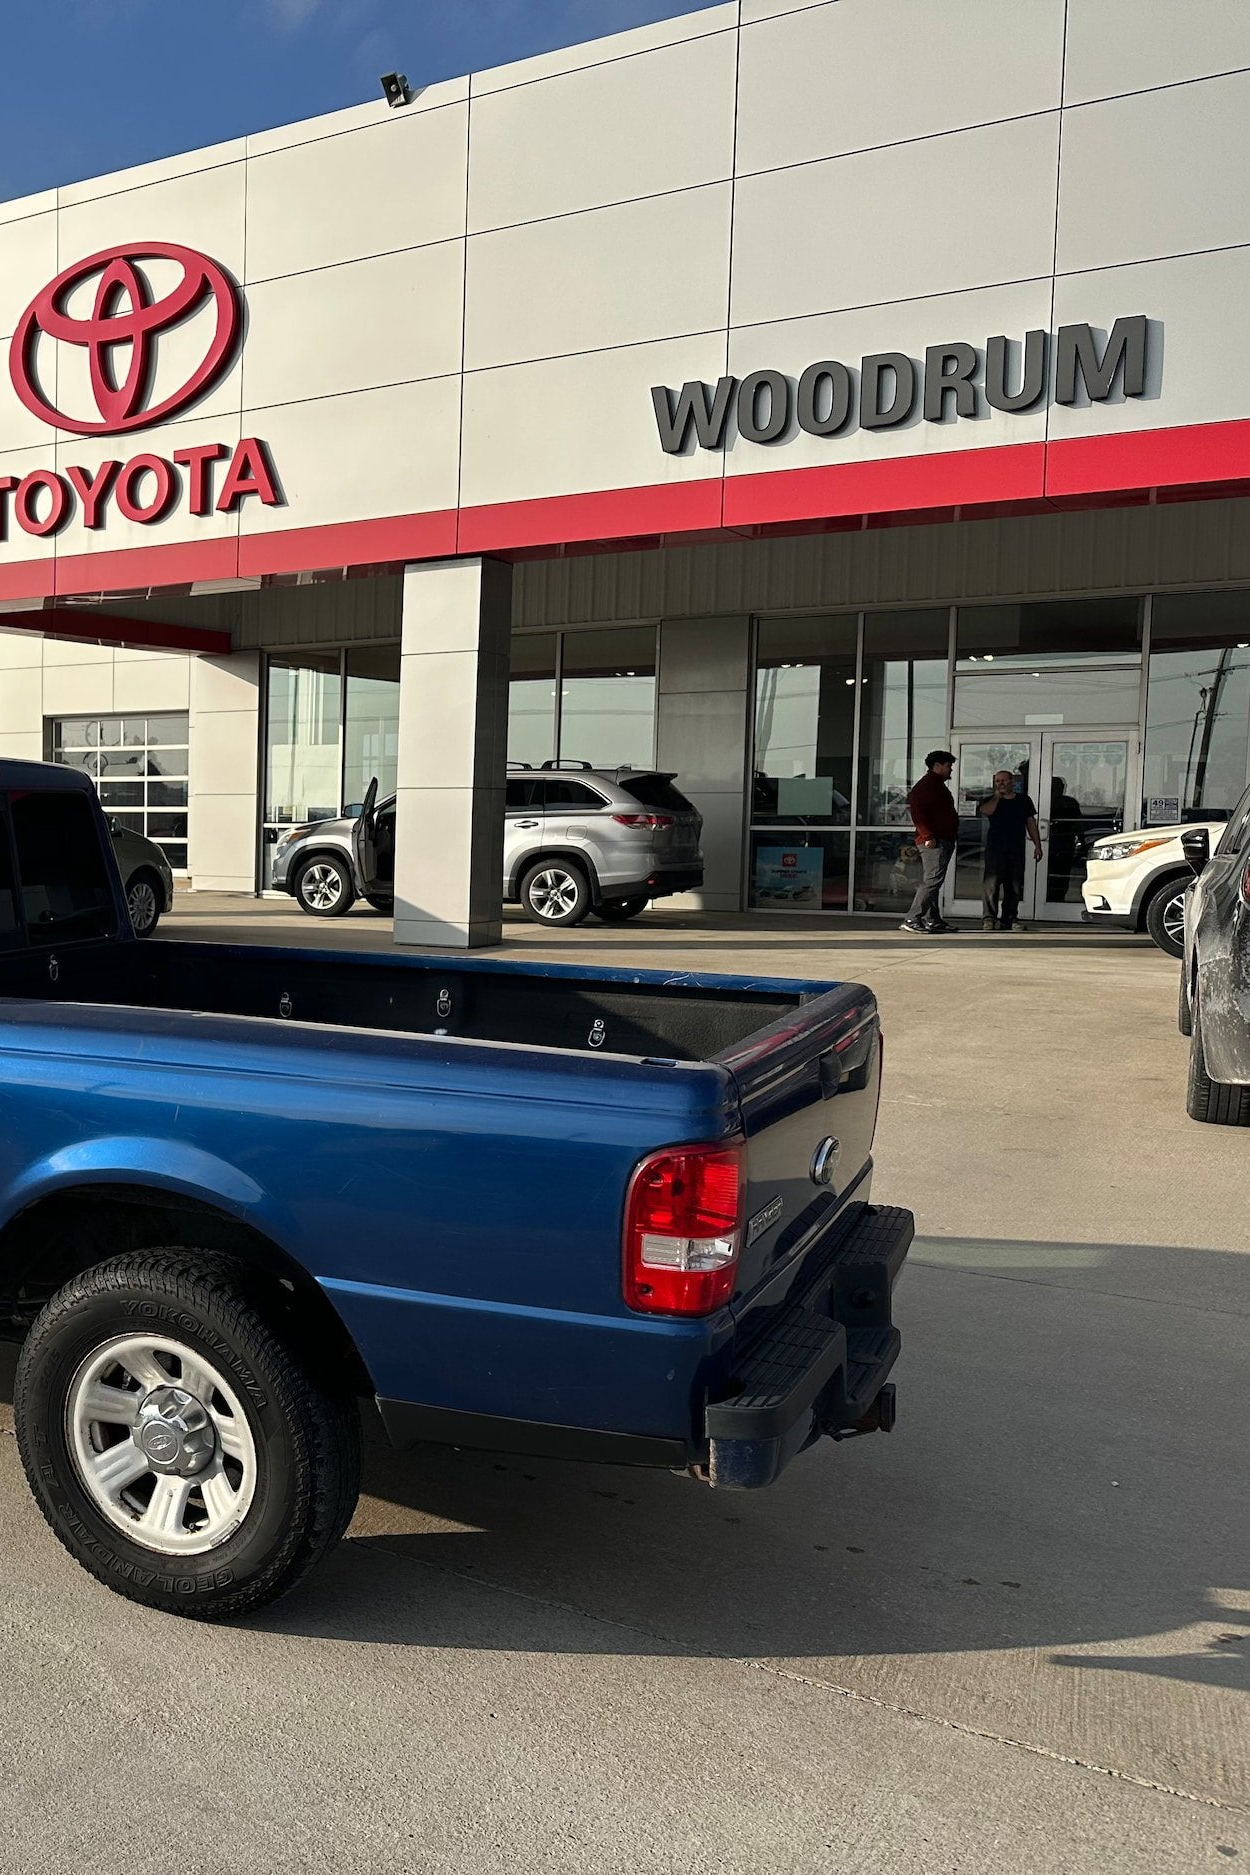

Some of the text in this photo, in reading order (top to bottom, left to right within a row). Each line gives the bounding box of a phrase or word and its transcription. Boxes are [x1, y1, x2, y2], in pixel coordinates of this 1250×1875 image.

[650, 315, 1147, 453] WOODRUM
[121, 1300, 266, 1408] YOKOHAMA
[59, 1503, 234, 1594] GEOLANDAR
